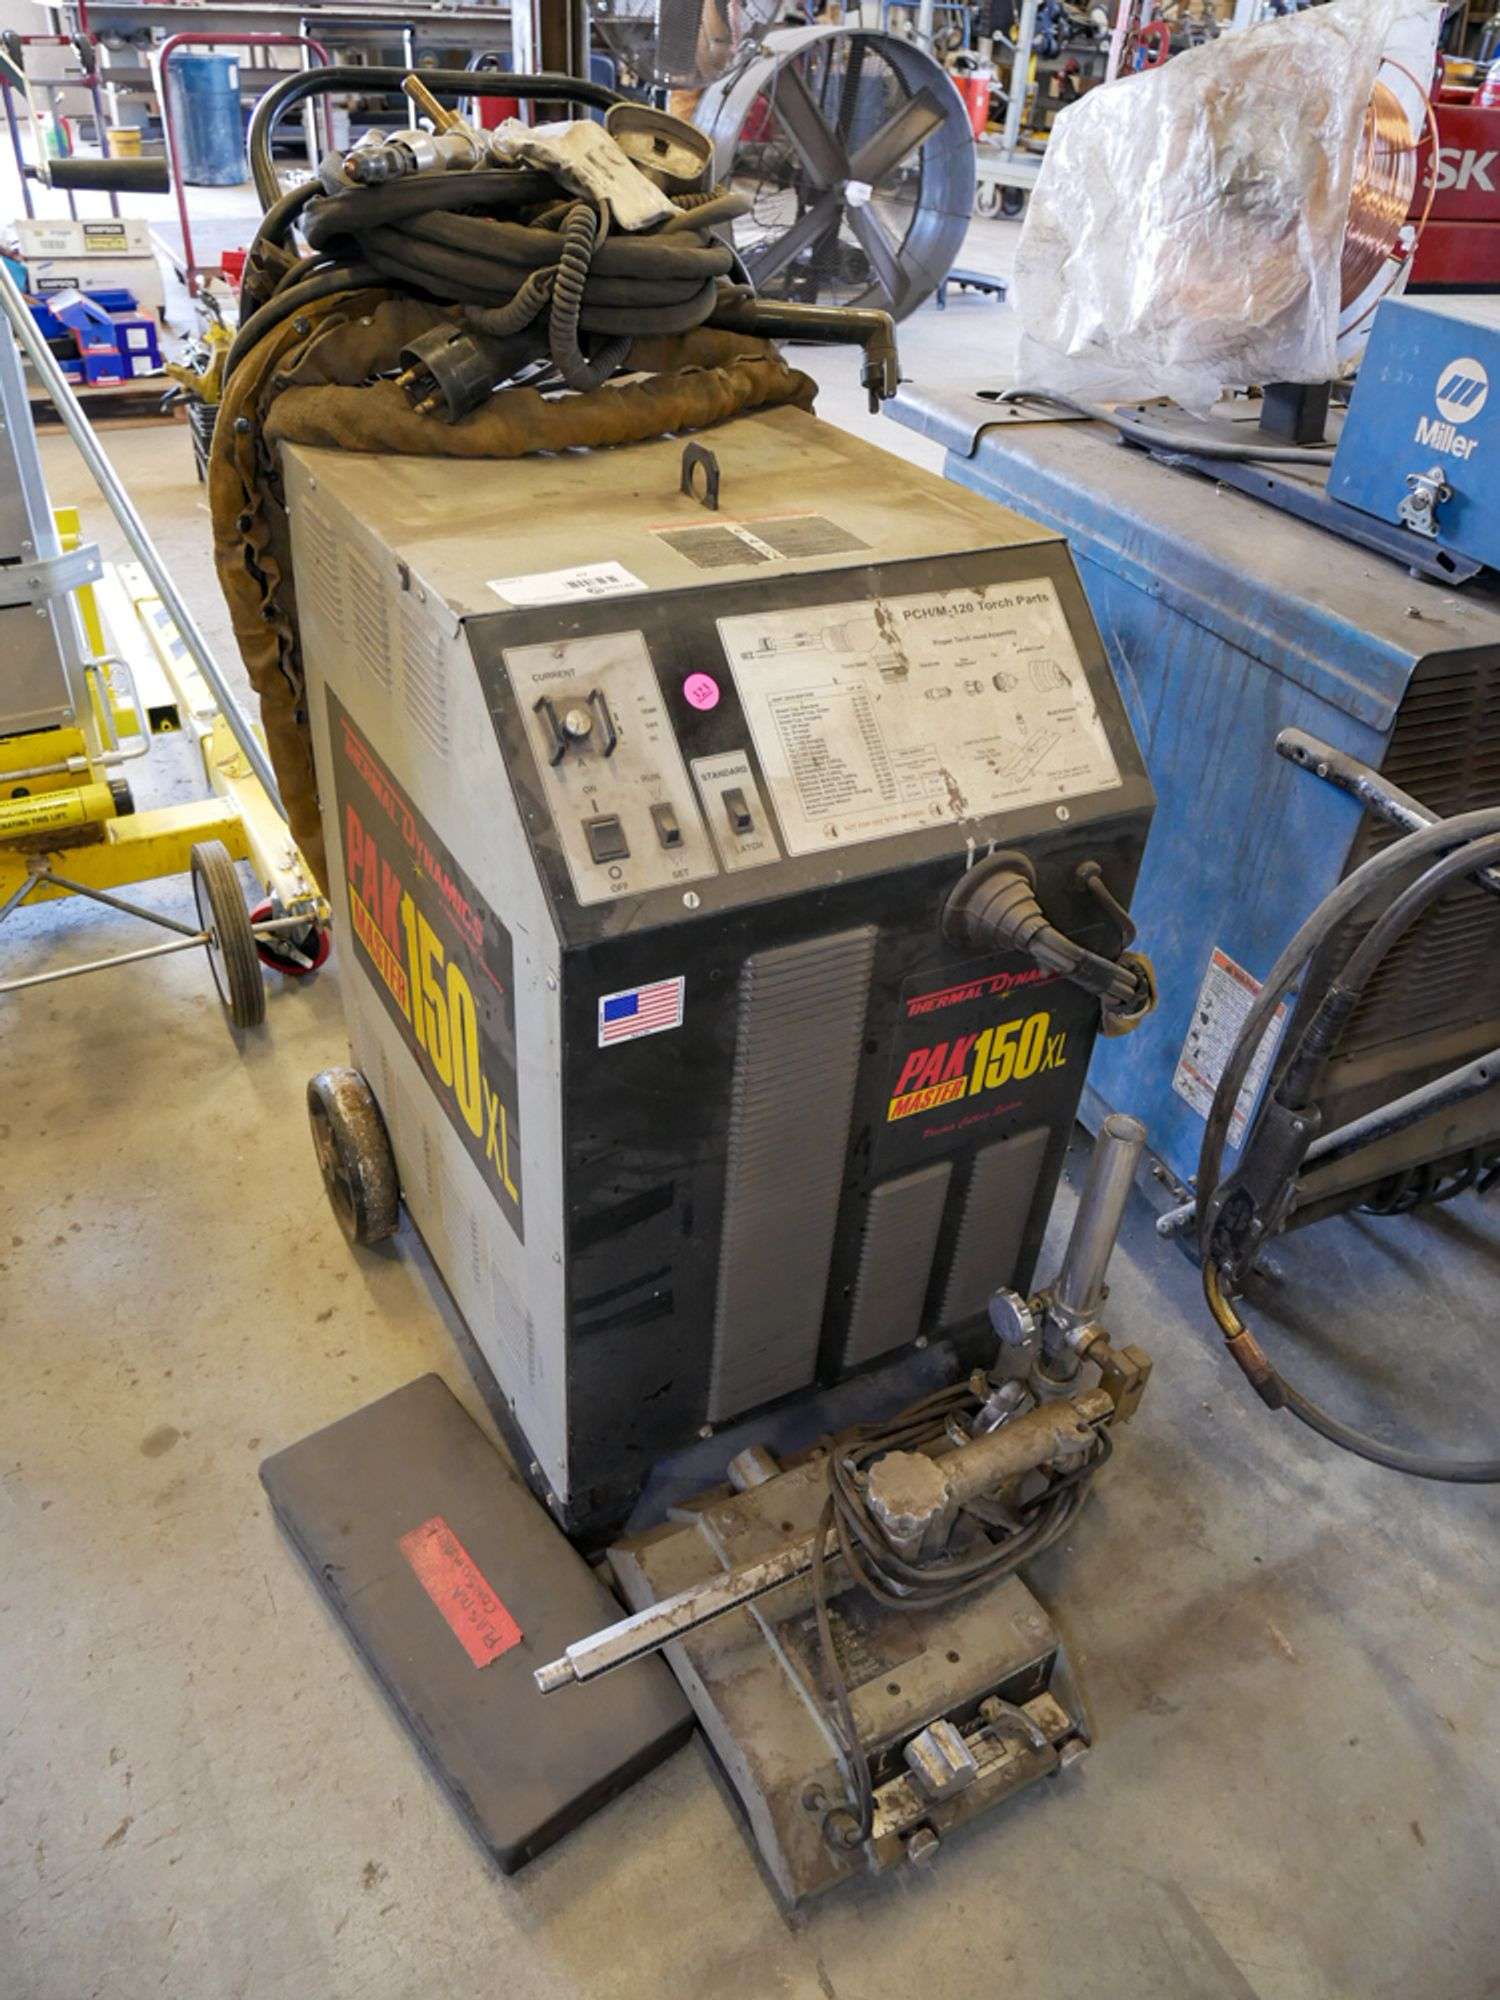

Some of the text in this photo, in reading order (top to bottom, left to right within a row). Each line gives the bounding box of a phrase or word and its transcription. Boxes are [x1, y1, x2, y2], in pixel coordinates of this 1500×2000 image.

[1413, 415, 1478, 460] Miller
[979, 597, 1013, 611] Torch
[1015, 593, 1050, 605] Parts
[531, 668, 577, 682] CURRENT
[700, 764, 748, 782] STANDARD
[582, 784, 597, 795] ON
[341, 716, 485, 946] THERMAL DYNAMICS
[346, 803, 401, 961] PAK
[671, 868, 689, 880] SET
[609, 882, 628, 893] OFF
[907, 984, 984, 1018] THERMAL
[893, 1033, 977, 1096] PAK
[891, 1081, 964, 1119] MASTER
